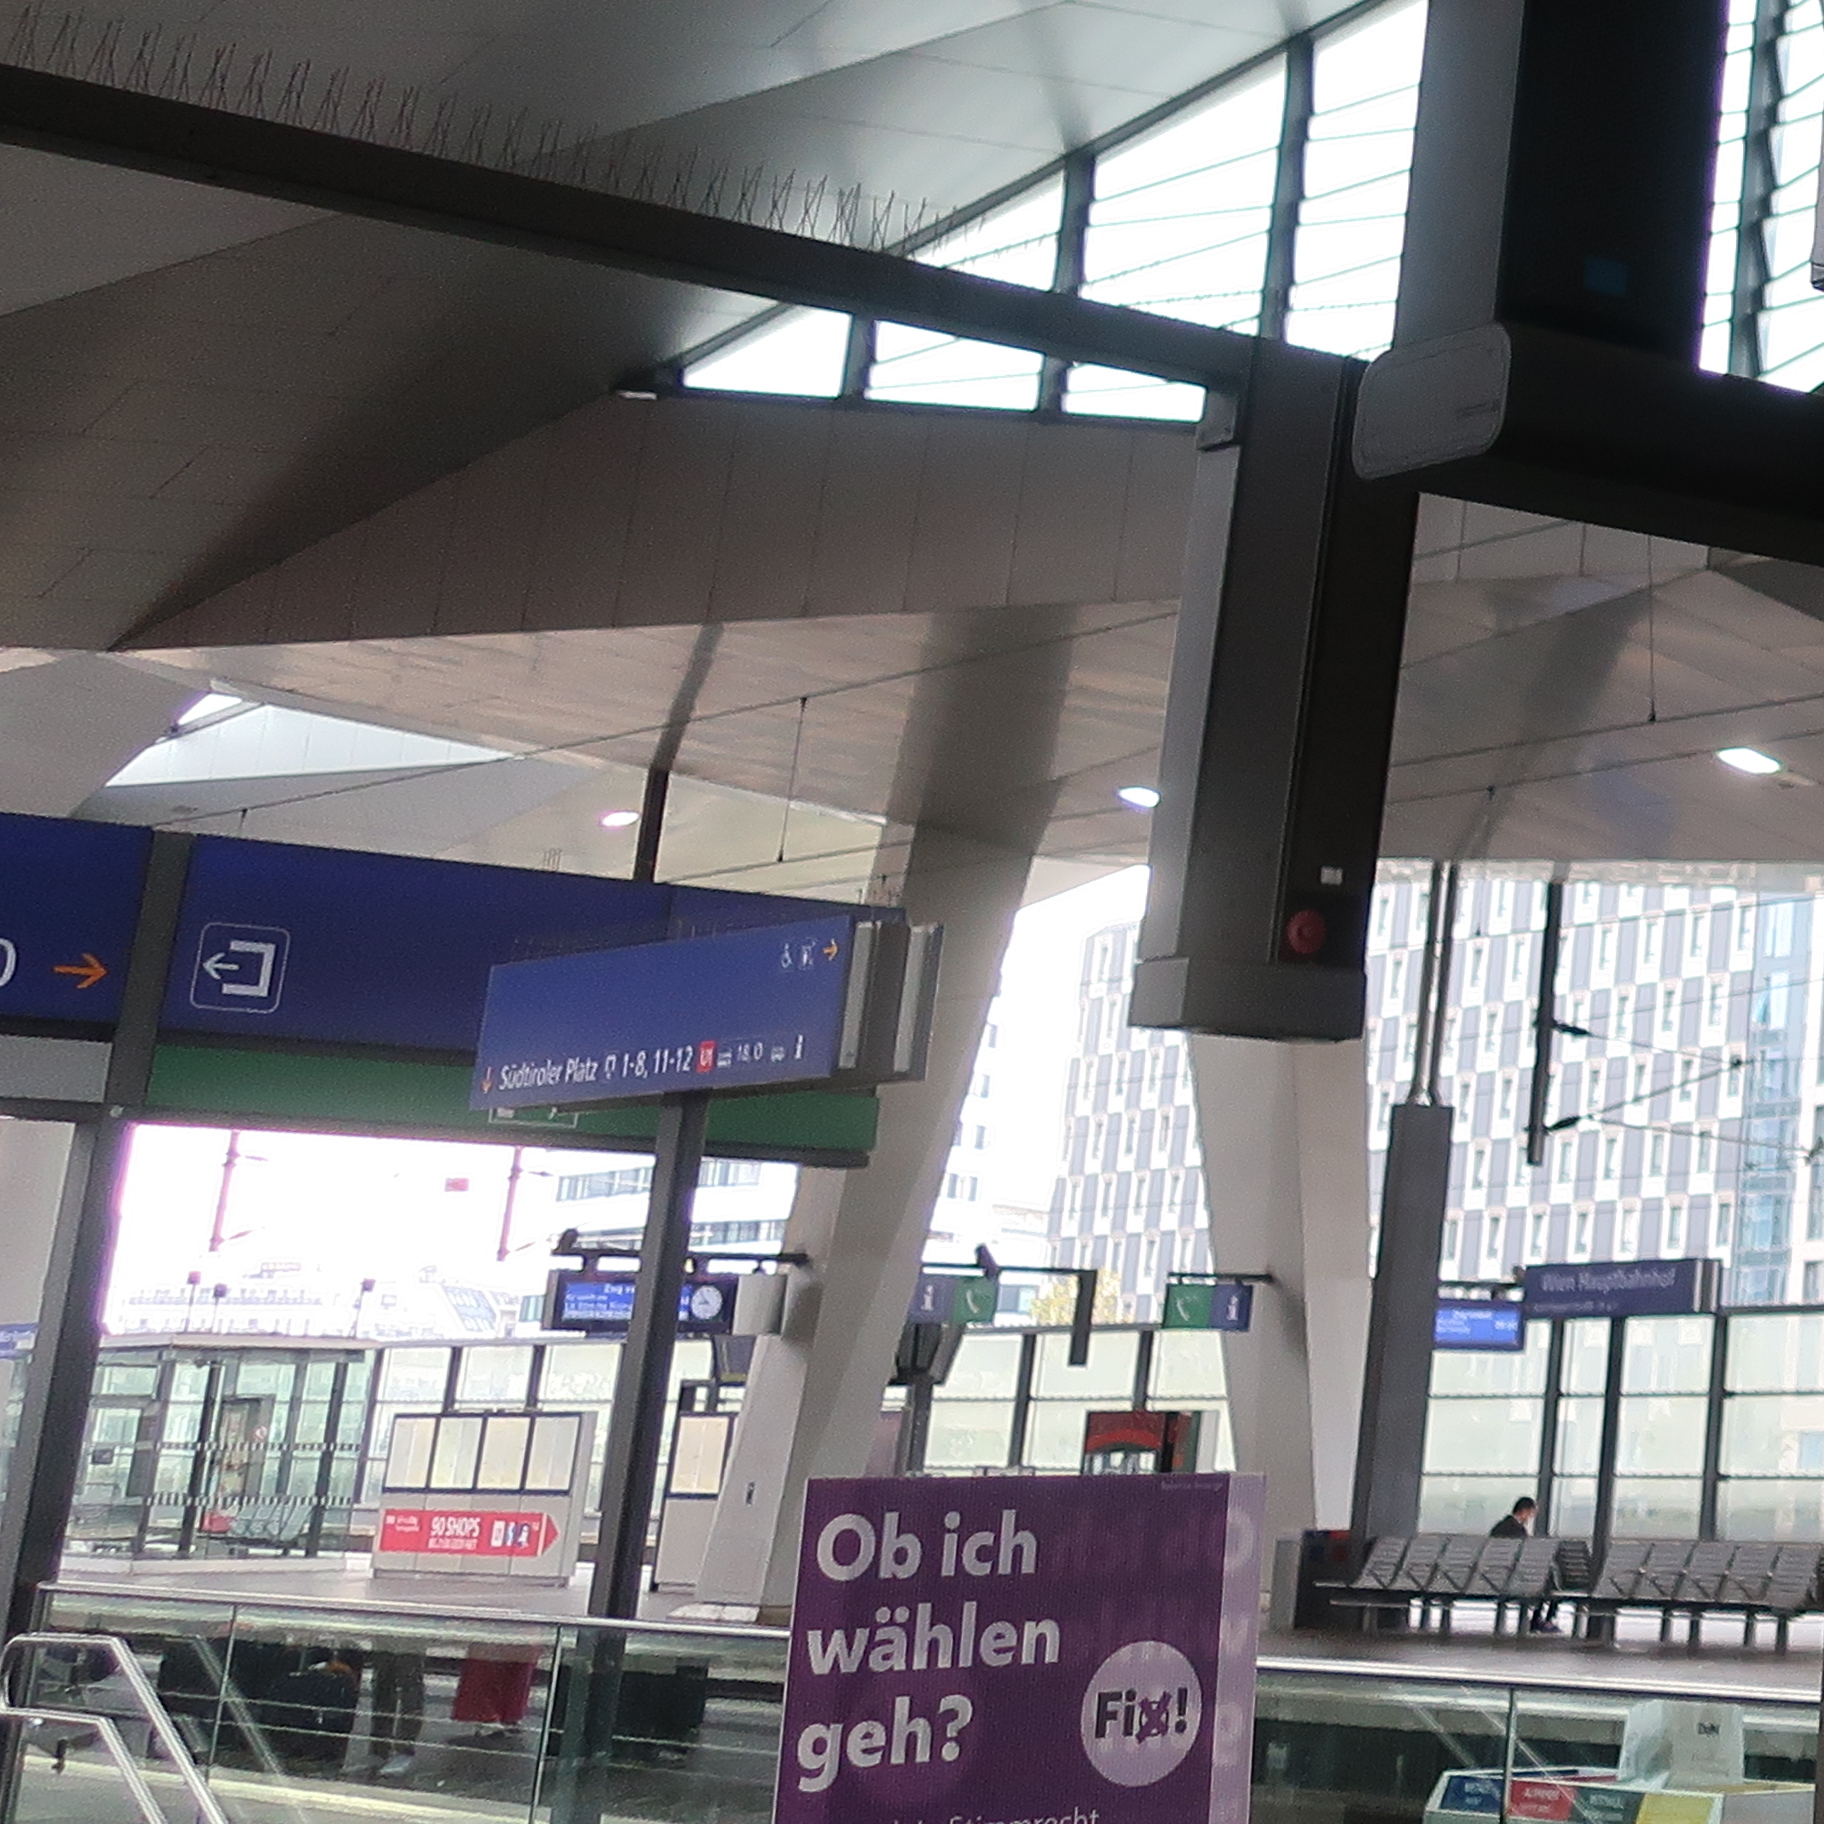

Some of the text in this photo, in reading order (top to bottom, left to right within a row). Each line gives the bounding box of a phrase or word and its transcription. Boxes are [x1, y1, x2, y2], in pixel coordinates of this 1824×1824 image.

[499, 1056, 563, 1090] Südtiroler
[564, 1056, 598, 1083] Platz
[652, 1046, 694, 1074] 11-12
[446, 1516, 481, 1538] SHOPS
[816, 1509, 1039, 1582] Ob ich
[806, 1600, 1061, 1675] wählen
[797, 1693, 974, 1794] geh?
[1095, 1687, 1189, 1745] Fix!
